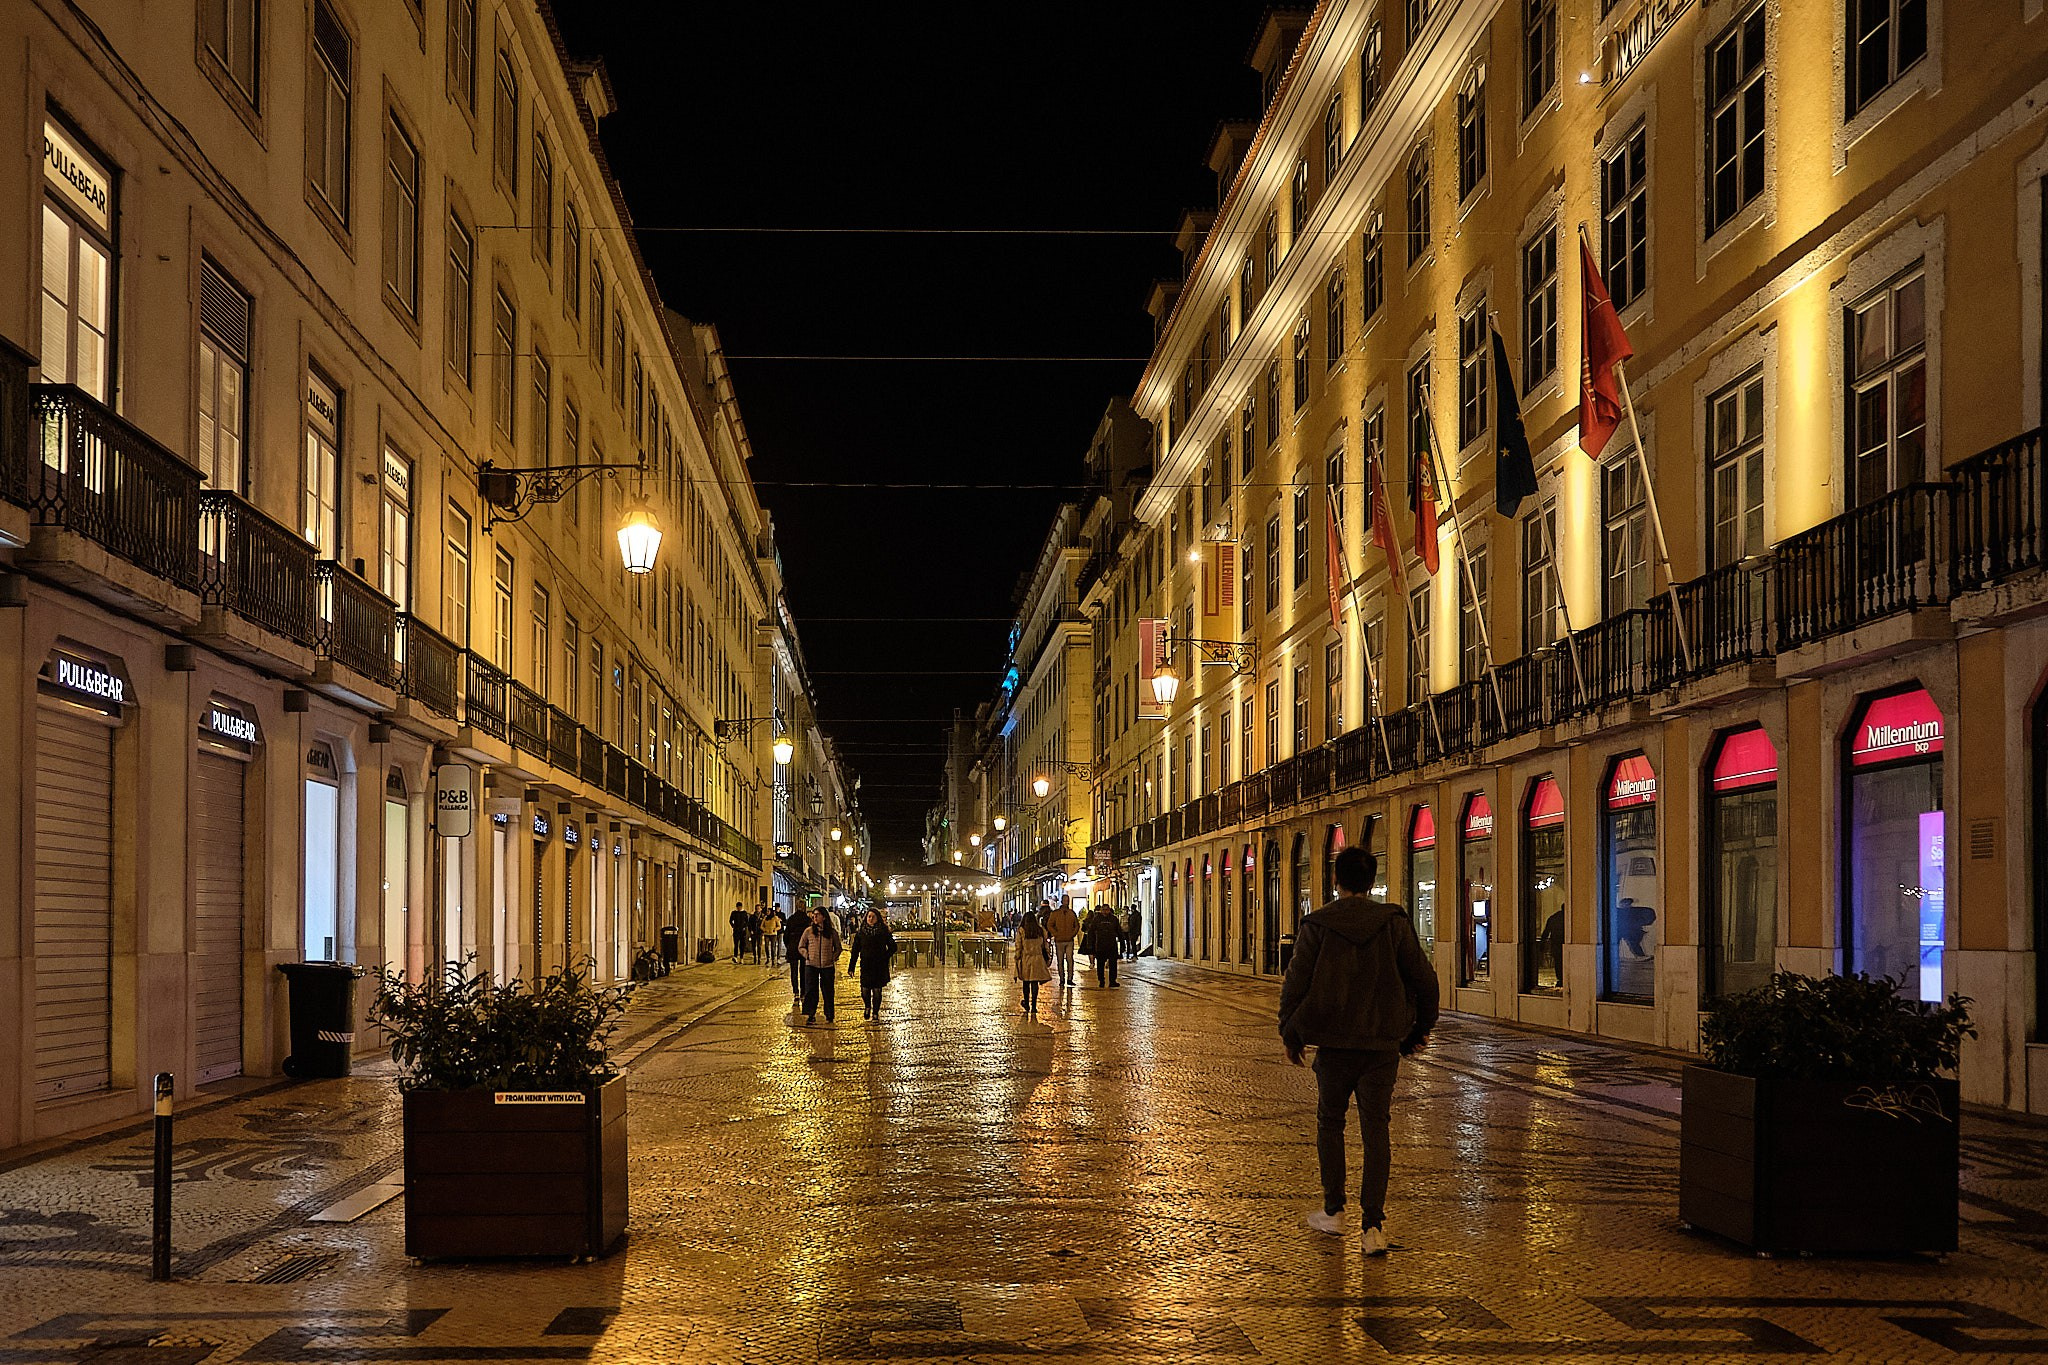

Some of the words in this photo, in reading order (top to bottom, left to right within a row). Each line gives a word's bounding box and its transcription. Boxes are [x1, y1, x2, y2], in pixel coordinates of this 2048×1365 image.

[43, 136, 106, 215] PULL&BEAR
[59, 659, 123, 702] PULL&BEAR
[212, 710, 256, 742] PULL&BEAR
[1867, 720, 1939, 749] Millennium
[1915, 742, 1929, 753] bcp
[439, 789, 468, 804] P&B
[505, 1094, 524, 1102] FROM
[547, 1094, 564, 1102] WITH
